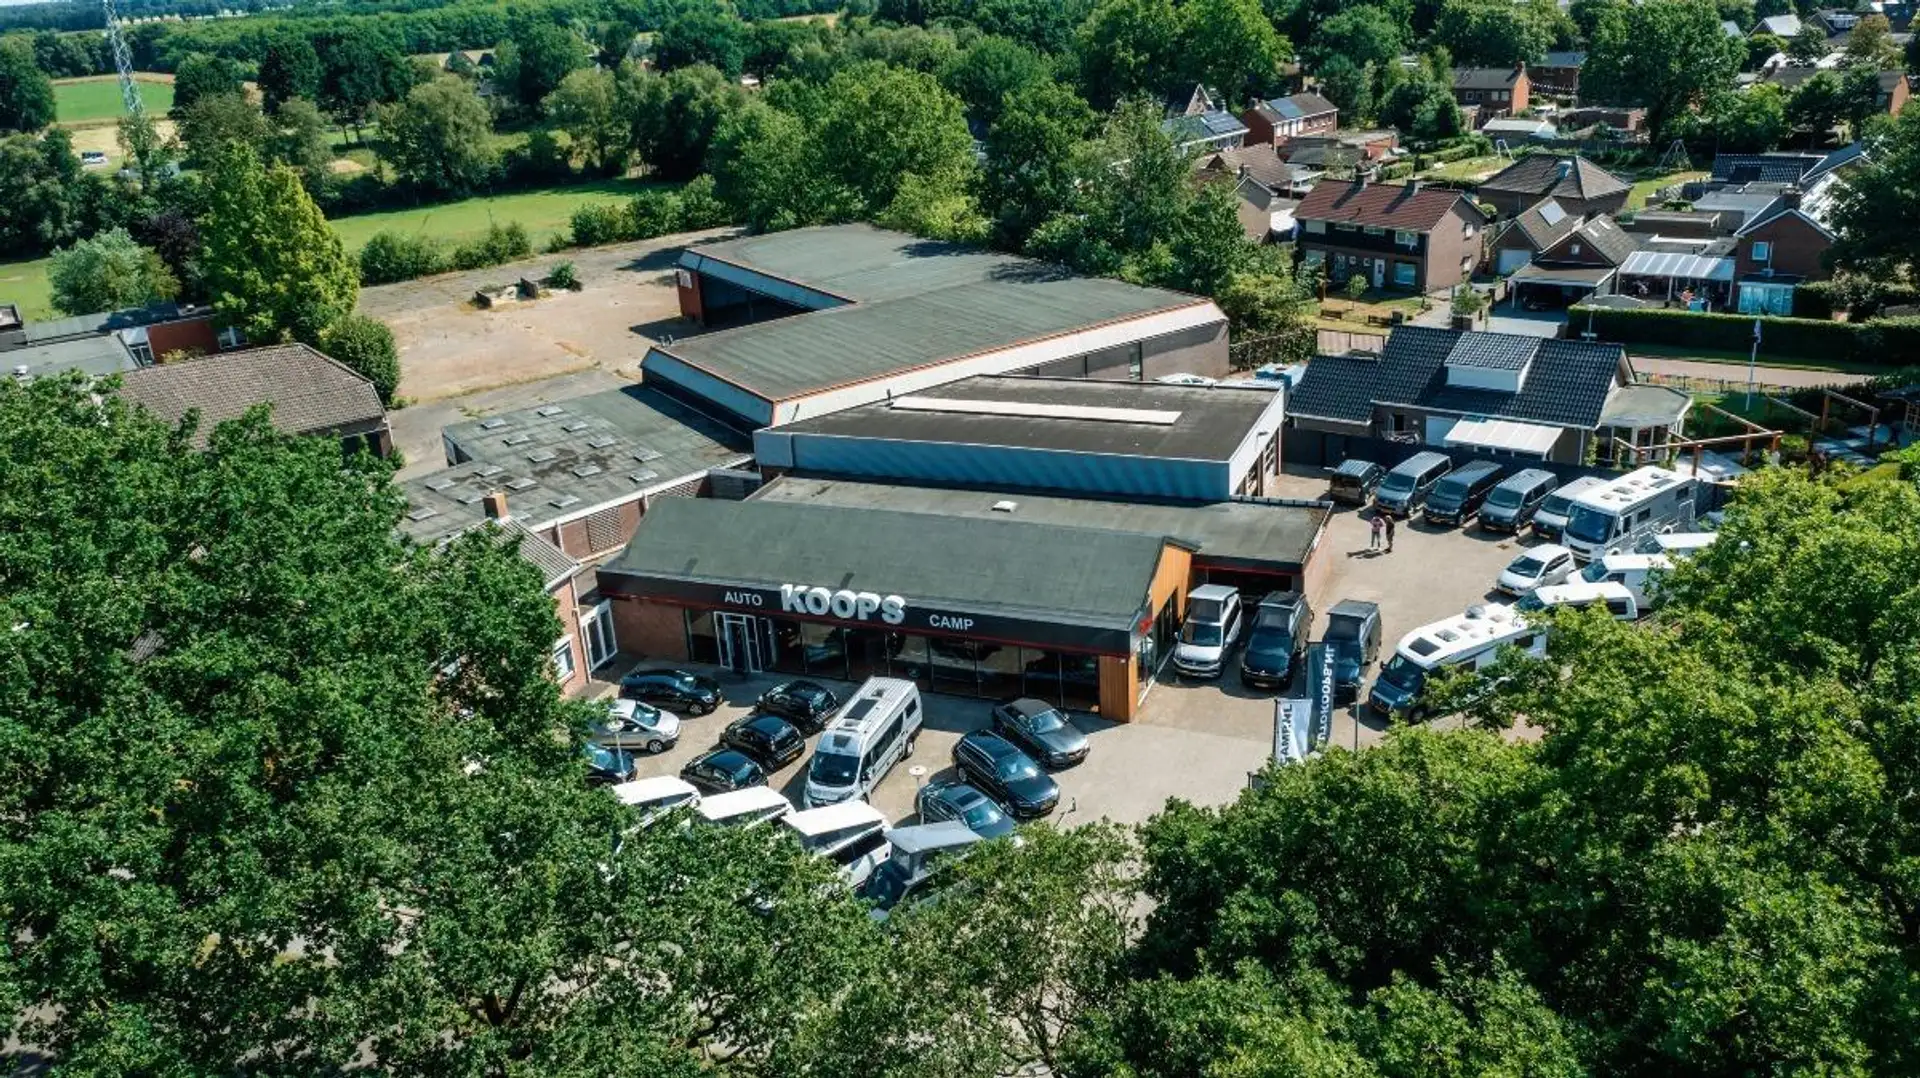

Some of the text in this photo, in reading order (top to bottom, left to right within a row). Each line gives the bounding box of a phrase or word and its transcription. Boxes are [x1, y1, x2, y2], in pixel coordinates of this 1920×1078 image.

[724, 583, 975, 631] AUTO KOOPS CAMP
